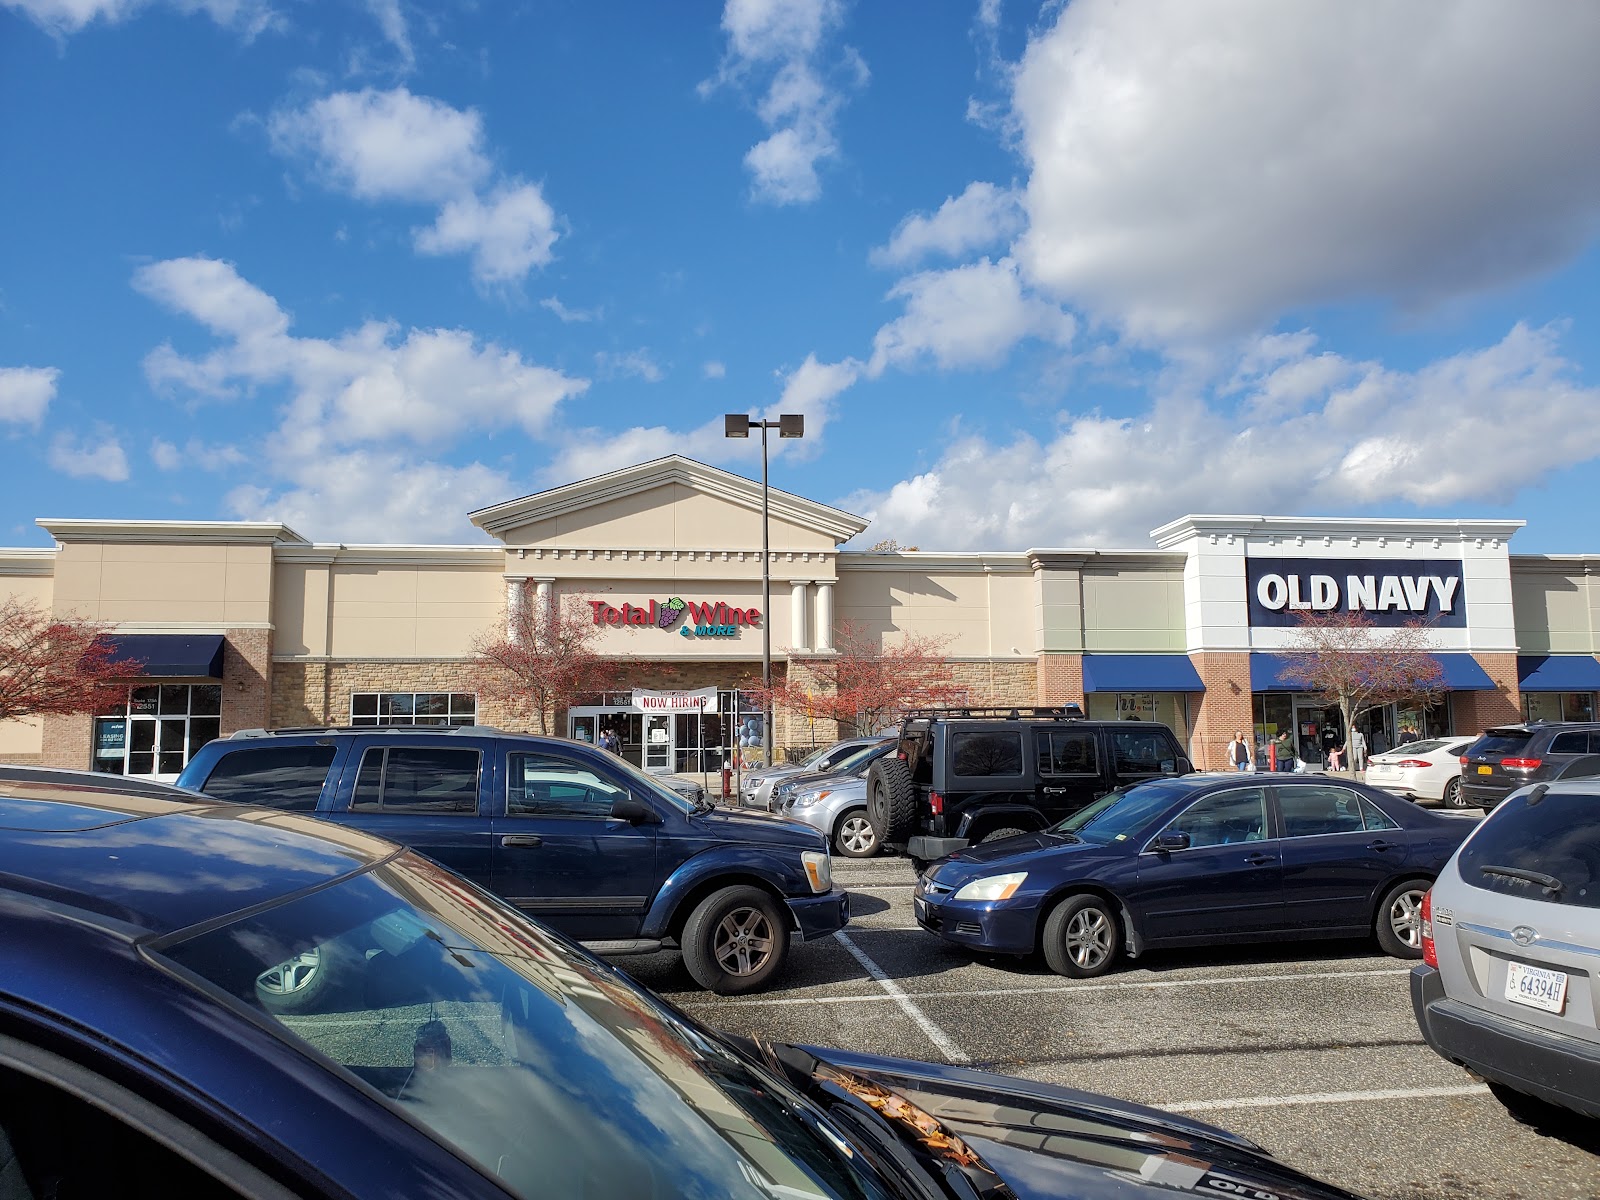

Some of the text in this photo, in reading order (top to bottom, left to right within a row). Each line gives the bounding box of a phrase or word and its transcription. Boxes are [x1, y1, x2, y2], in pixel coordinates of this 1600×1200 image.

[1257, 574, 1459, 611] OLD NAVY
[588, 599, 760, 626] Total Wine
[680, 625, 736, 637] & MORE
[643, 697, 667, 708] NOW
[1522, 966, 1551, 980] VIRGINIA
[1520, 975, 1562, 1002] 64394H
